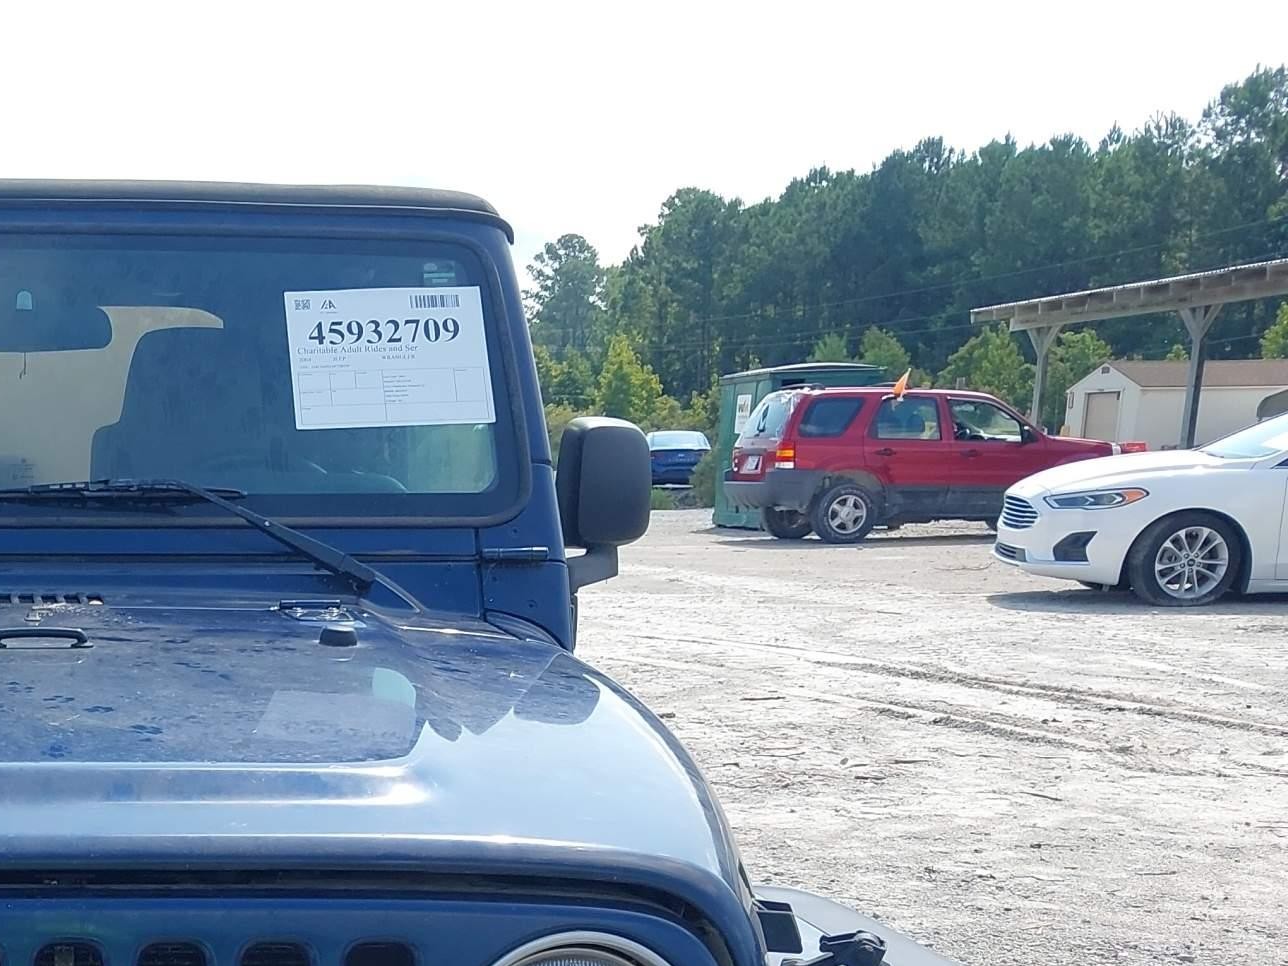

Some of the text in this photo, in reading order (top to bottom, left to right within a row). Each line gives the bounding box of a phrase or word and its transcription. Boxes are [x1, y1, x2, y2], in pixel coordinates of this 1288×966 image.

[308, 318, 461, 346] 45932709
[297, 344, 418, 355] Charitable Adult Rides and Ser
